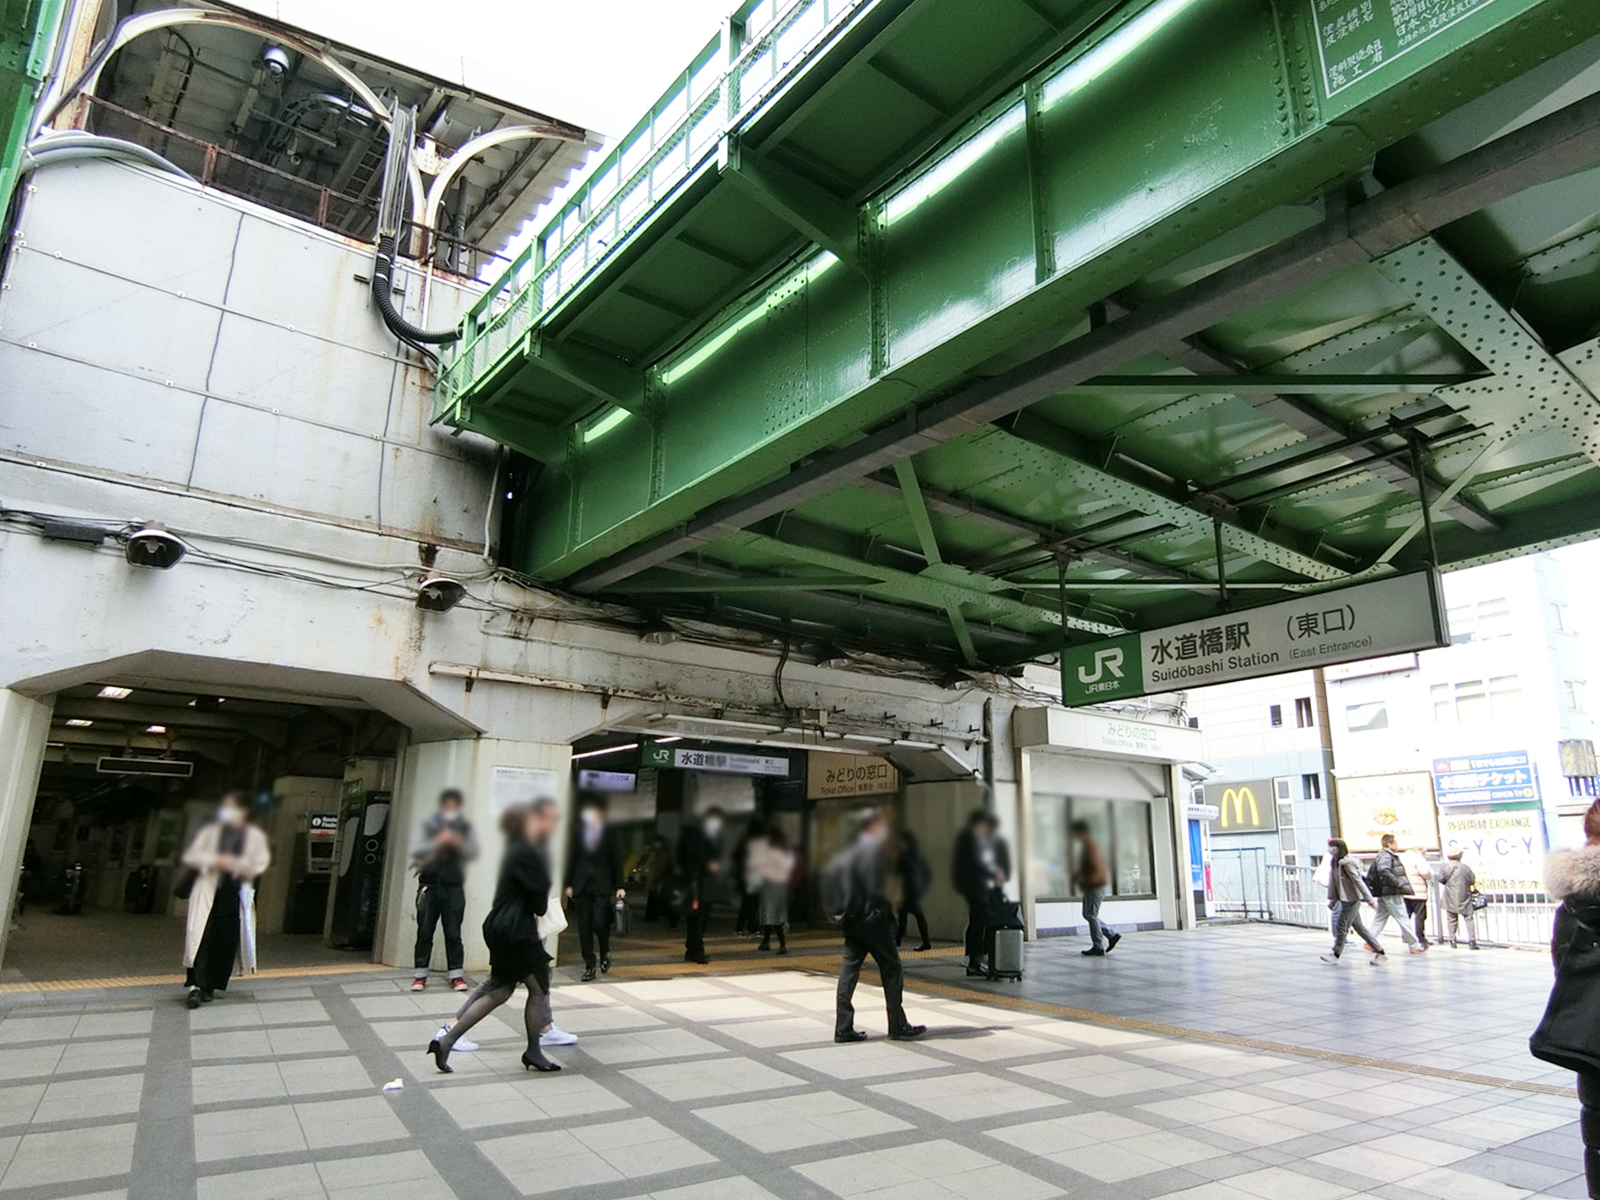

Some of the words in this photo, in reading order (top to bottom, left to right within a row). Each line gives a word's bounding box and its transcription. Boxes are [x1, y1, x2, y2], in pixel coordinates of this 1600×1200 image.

[1151, 621, 1250, 665] 水道橋駅
[1285, 604, 1356, 642] （東口）
[1077, 647, 1125, 684] JR
[1151, 658, 1224, 683] Suidōbashi
[1228, 651, 1279, 671] Station
[1288, 645, 1317, 661] (East
[1319, 635, 1373, 656] Entrance)
[1085, 680, 1120, 695] JR東日本
[1107, 723, 1157, 741] みどりの窓口
[653, 749, 669, 760] JR
[825, 764, 888, 783] みどりの窓口
[1489, 816, 1531, 829] EXCHANGE
